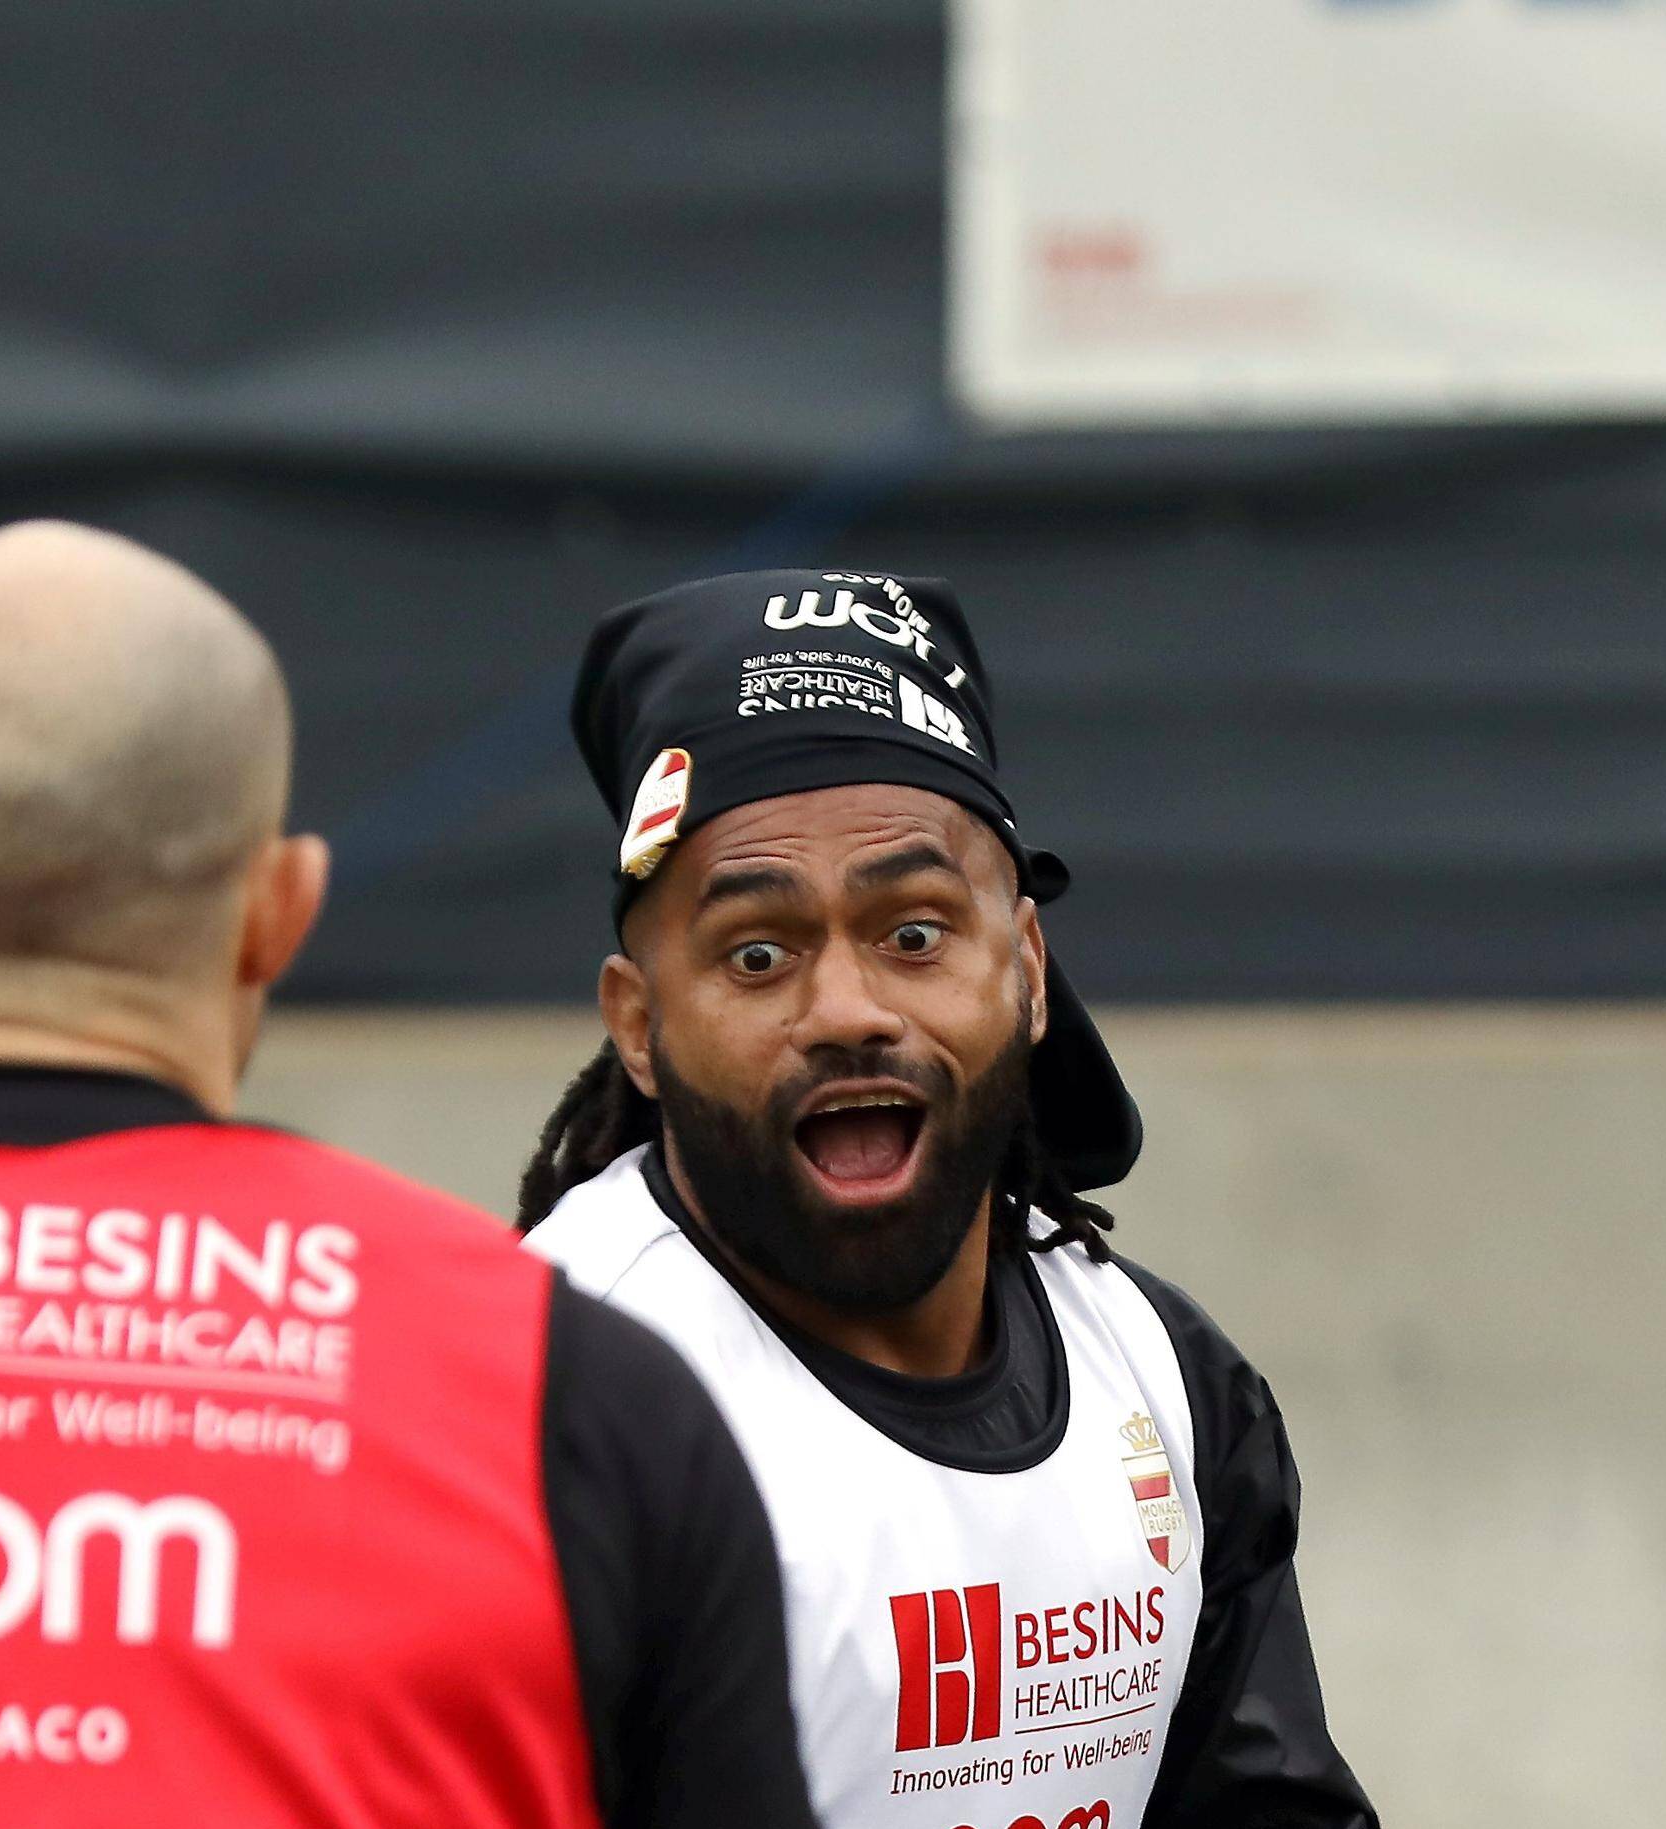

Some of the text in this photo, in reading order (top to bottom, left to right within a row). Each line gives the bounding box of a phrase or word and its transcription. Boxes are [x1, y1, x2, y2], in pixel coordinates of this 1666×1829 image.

[738, 671, 894, 706] HEALTHCARE
[741, 648, 894, 680] By your side, for life
[52, 1389, 351, 1474] Well-being
[1014, 1584, 1165, 1670] BESINS
[1014, 1657, 1162, 1720] HEALTHCARE
[889, 1726, 1152, 1797] Innovating for Well-being
